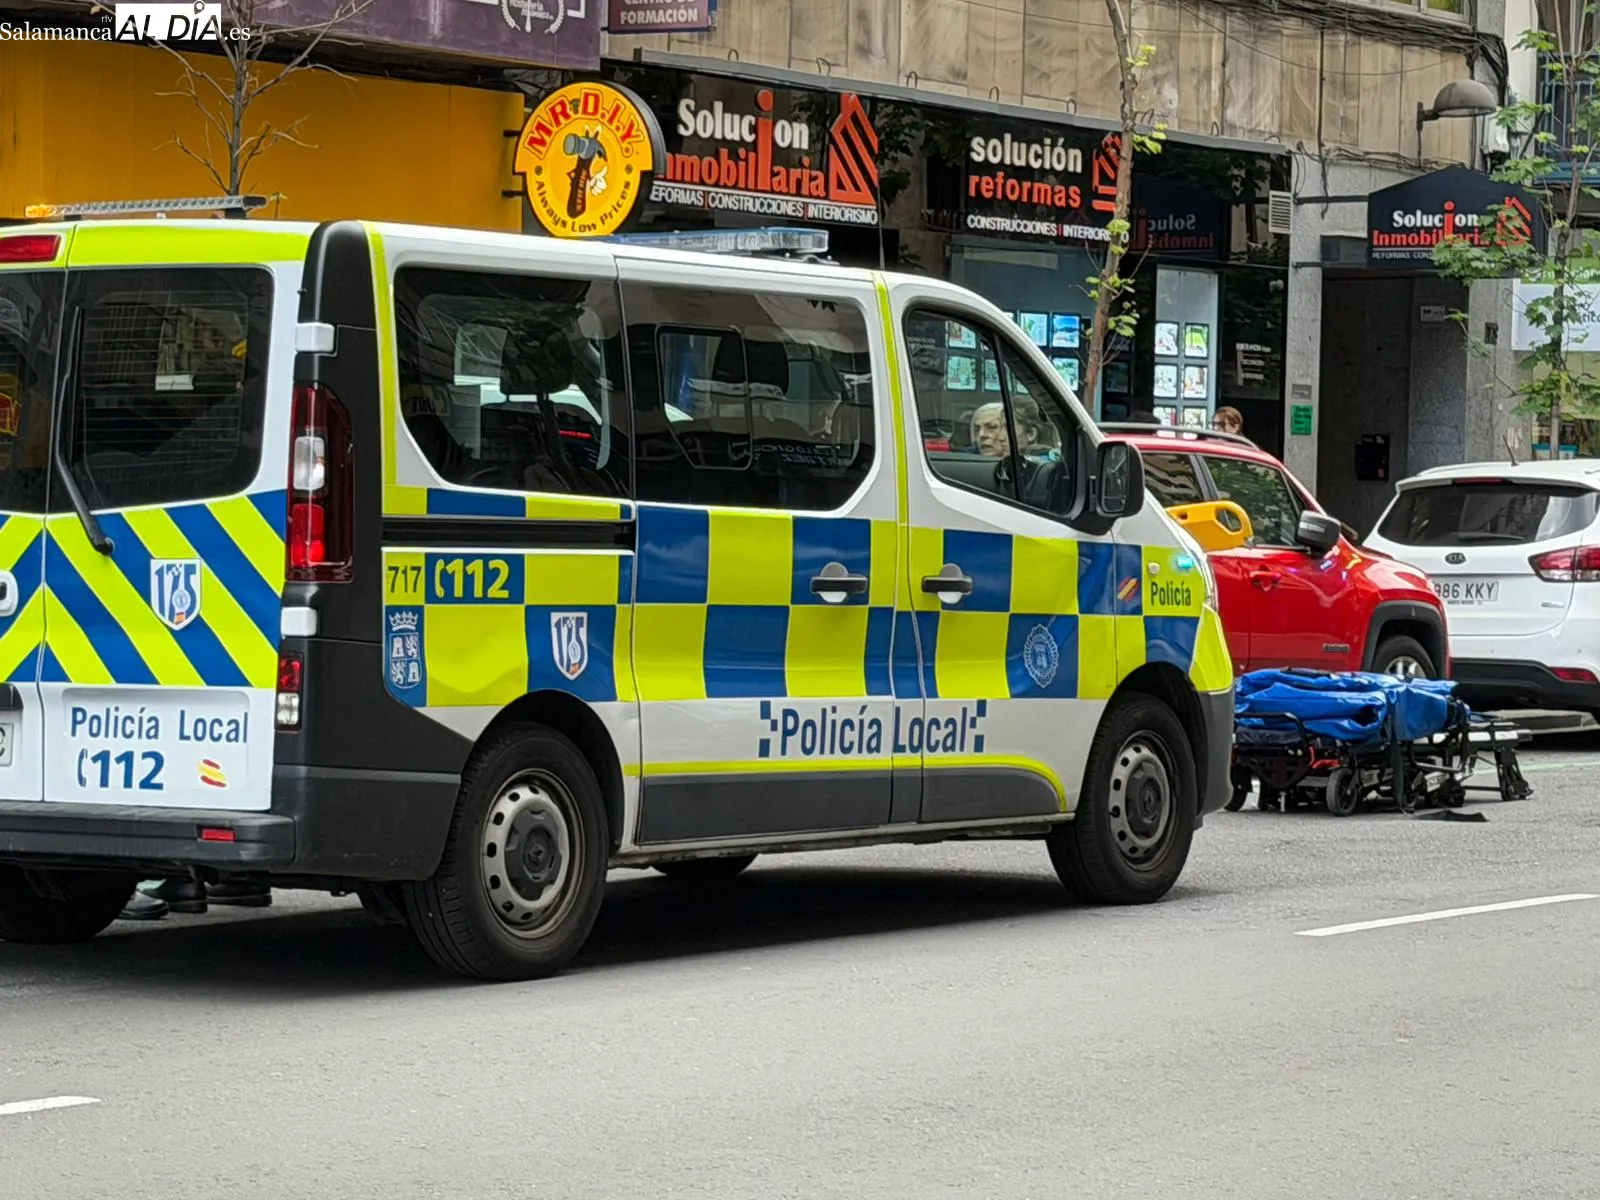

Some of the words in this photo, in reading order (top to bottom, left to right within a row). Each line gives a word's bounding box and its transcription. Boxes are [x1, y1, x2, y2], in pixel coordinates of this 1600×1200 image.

[620, 5, 698, 25] FORMACIÓN
[969, 133, 1082, 174] solución
[535, 180, 568, 229] Always
[571, 221, 597, 233] Low
[650, 185, 704, 207] EFORMAS
[708, 192, 804, 217] CONSTRUCCIONES
[807, 204, 878, 225] INTERIORISMO
[968, 171, 1081, 209] reformas
[967, 214, 1057, 236] CONSTRUCCIONES
[387, 565, 422, 594] 717
[445, 558, 508, 599] 112
[1150, 580, 1192, 606] Policía
[1465, 583, 1495, 599] KKY
[70, 706, 160, 740] Policía
[178, 709, 248, 743] Local
[780, 704, 882, 756] Policía
[892, 705, 968, 754] Local
[90, 750, 165, 790] 112
